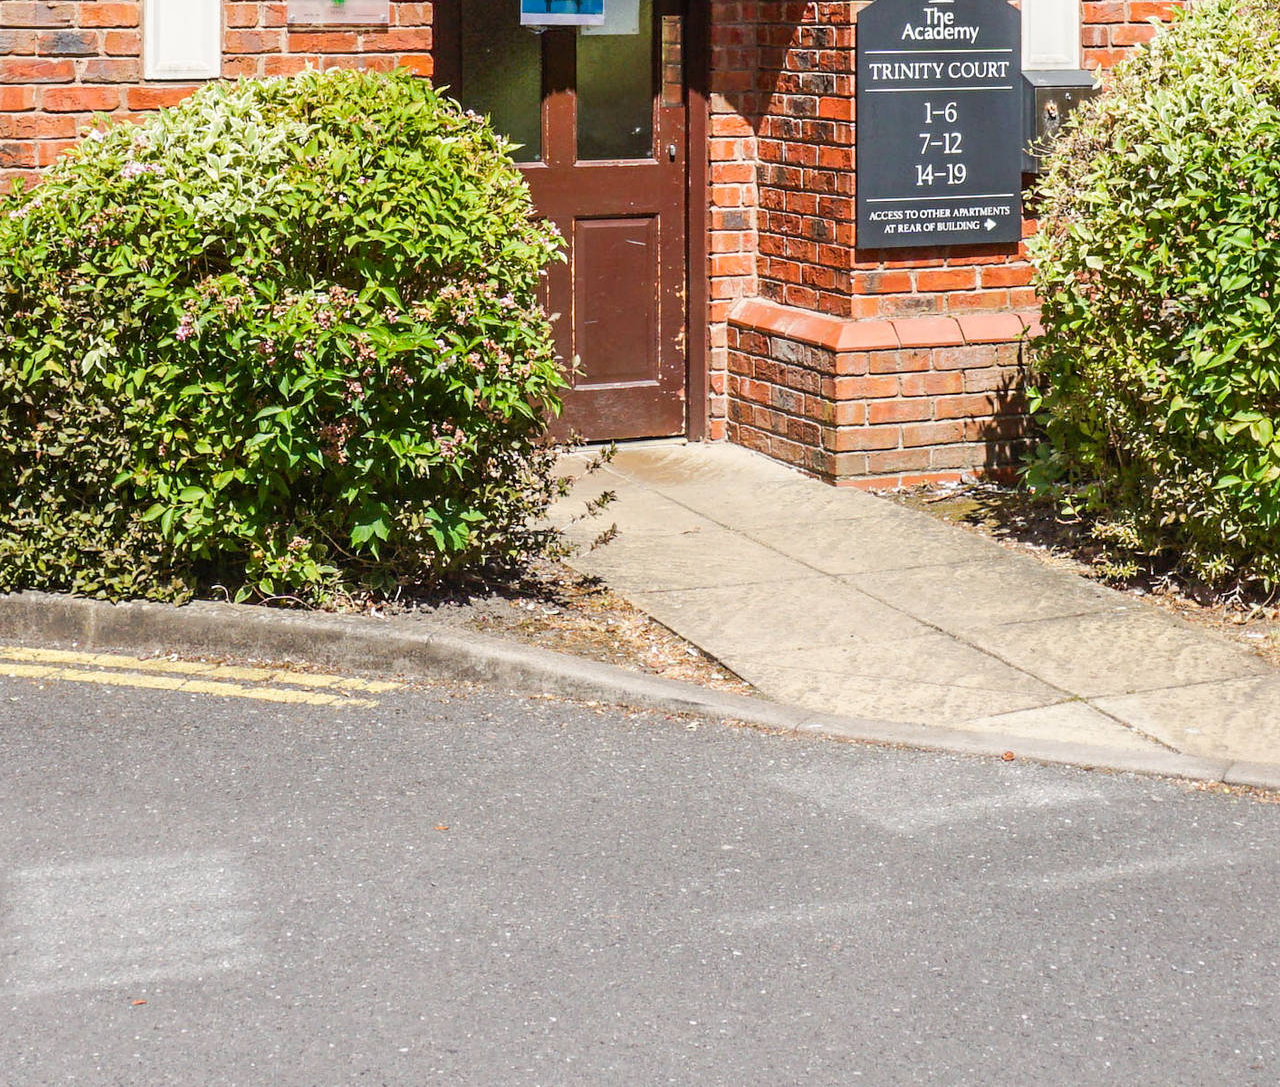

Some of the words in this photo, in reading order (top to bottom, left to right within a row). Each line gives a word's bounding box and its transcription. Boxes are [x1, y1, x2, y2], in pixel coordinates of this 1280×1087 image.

[923, 7, 954, 25] The
[901, 23, 979, 44] Academy
[869, 62, 944, 80] TRINITY
[948, 61, 1010, 79] COURT
[924, 101, 958, 124] 1-6
[919, 132, 963, 154] 7-12
[915, 163, 967, 186] 14-19
[869, 211, 903, 221] ACCESS
[904, 210, 919, 220] TO
[920, 208, 951, 218] OTHER
[952, 206, 1010, 217] APARTMENTS
[884, 224, 896, 234] AT
[897, 223, 922, 233] REAR
[923, 222, 936, 232] OF
[936, 220, 980, 231] BUILDING
